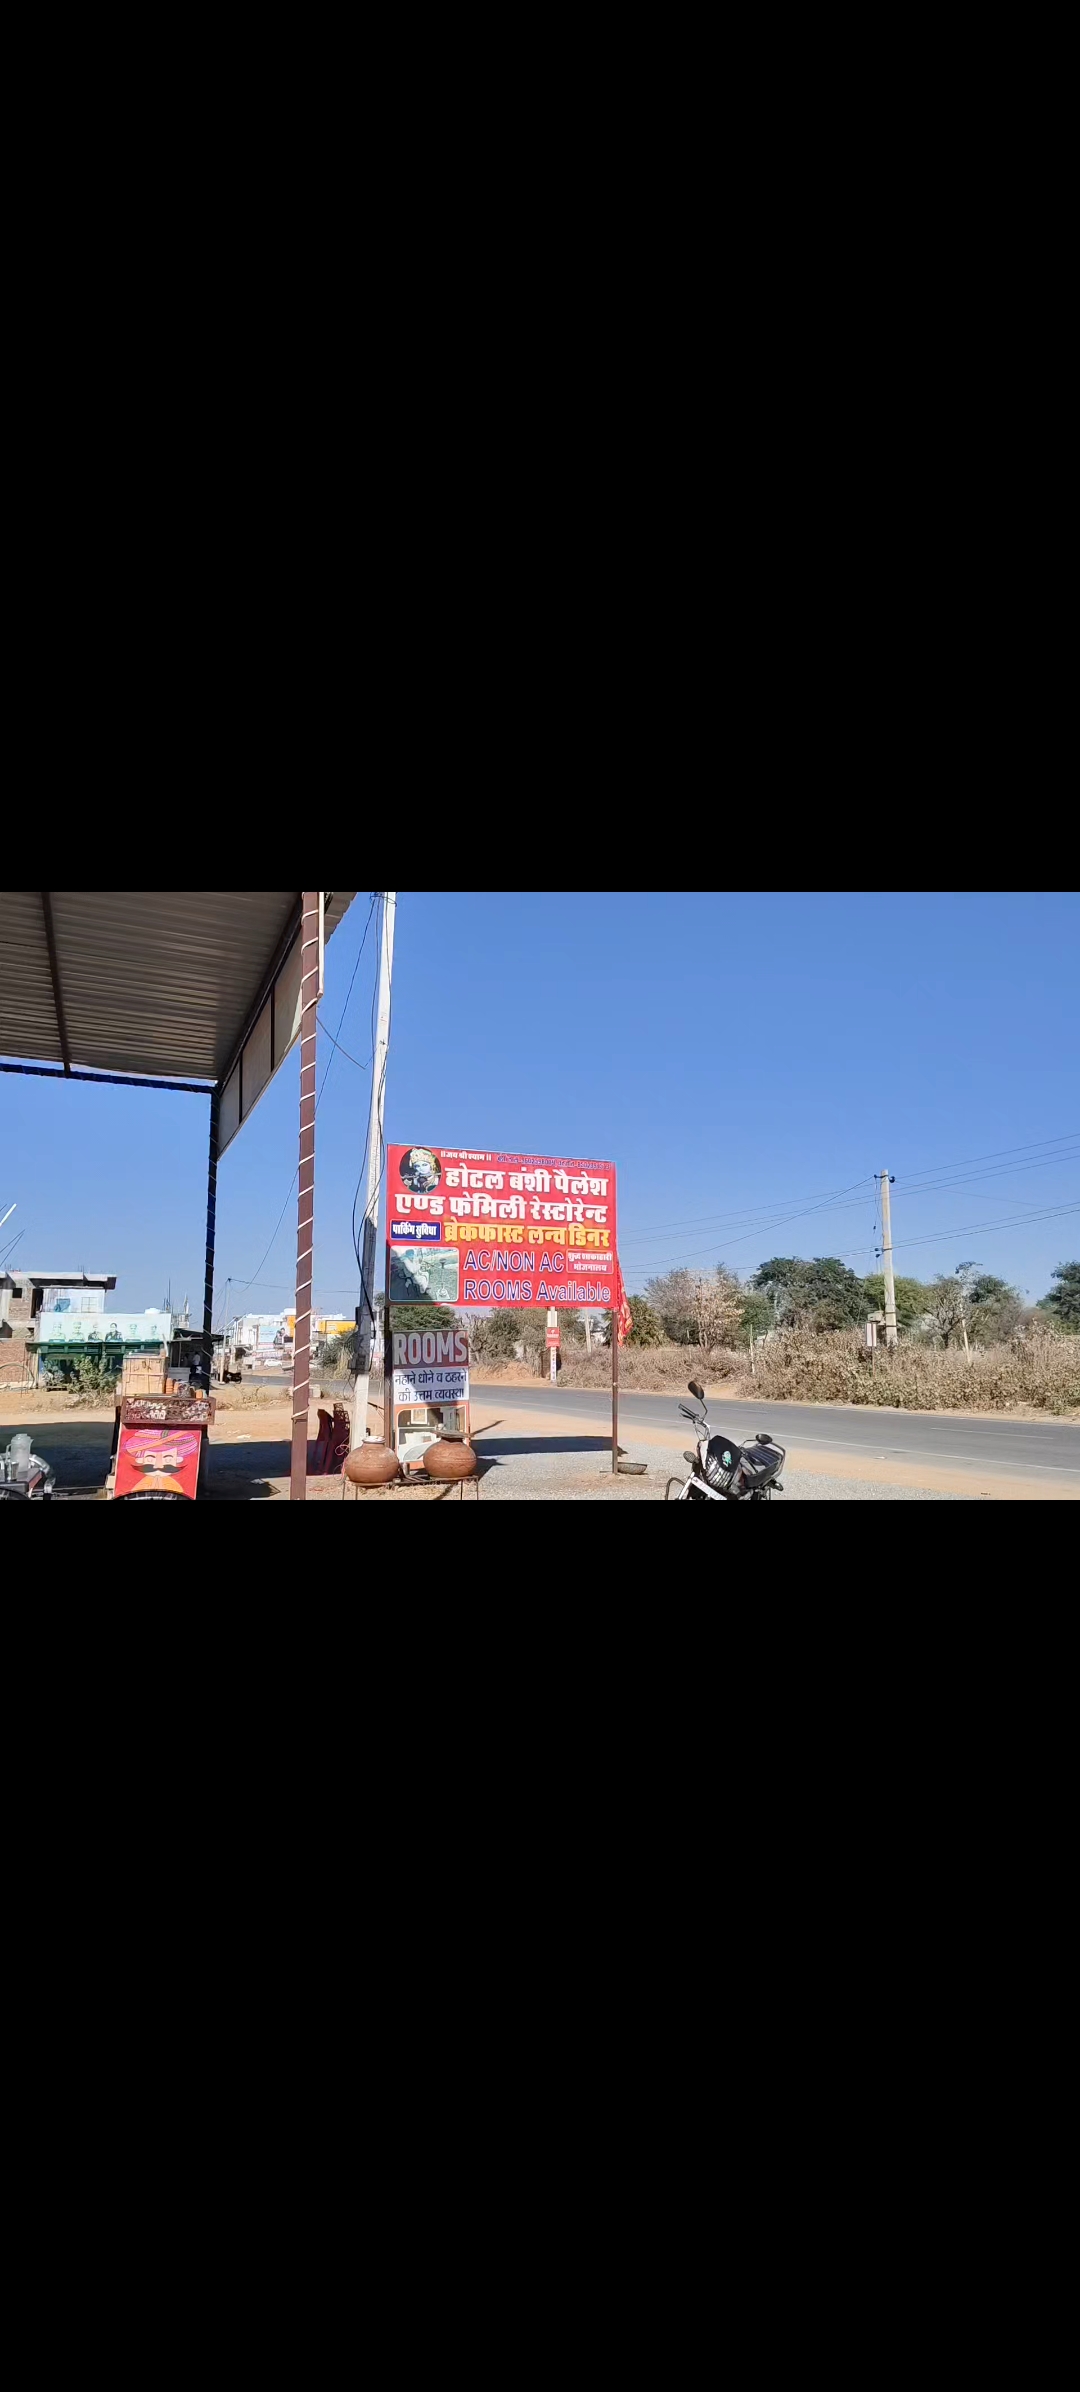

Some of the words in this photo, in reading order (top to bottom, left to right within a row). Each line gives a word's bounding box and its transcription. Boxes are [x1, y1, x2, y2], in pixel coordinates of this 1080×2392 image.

[445, 1163, 504, 1190] होटल
[510, 1167, 550, 1194] बंशी
[554, 1169, 608, 1197] पैलेश
[395, 1193, 444, 1215] एण्ड
[449, 1192, 526, 1220] फेमिली
[530, 1198, 608, 1223] रेस्टोरेन्ट
[416, 1223, 437, 1238] सुविधा
[444, 1217, 524, 1243] ब्रेकफास्ट
[528, 1225, 565, 1244] लन्च
[569, 1223, 611, 1247] डिनर
[463, 1249, 535, 1272] AC/NON
[539, 1252, 564, 1273] AC
[464, 1279, 532, 1301] ROOMS
[537, 1280, 611, 1302] Available
[394, 1331, 467, 1365] ROOMS
[395, 1371, 416, 1385] नहाने
[418, 1369, 434, 1384] धोने
[436, 1372, 442, 1382] व
[445, 1369, 466, 1382] ठहरने
[398, 1388, 410, 1402] की
[414, 1390, 432, 1401] उत्तम
[434, 1388, 464, 1399] व्यवस्था
